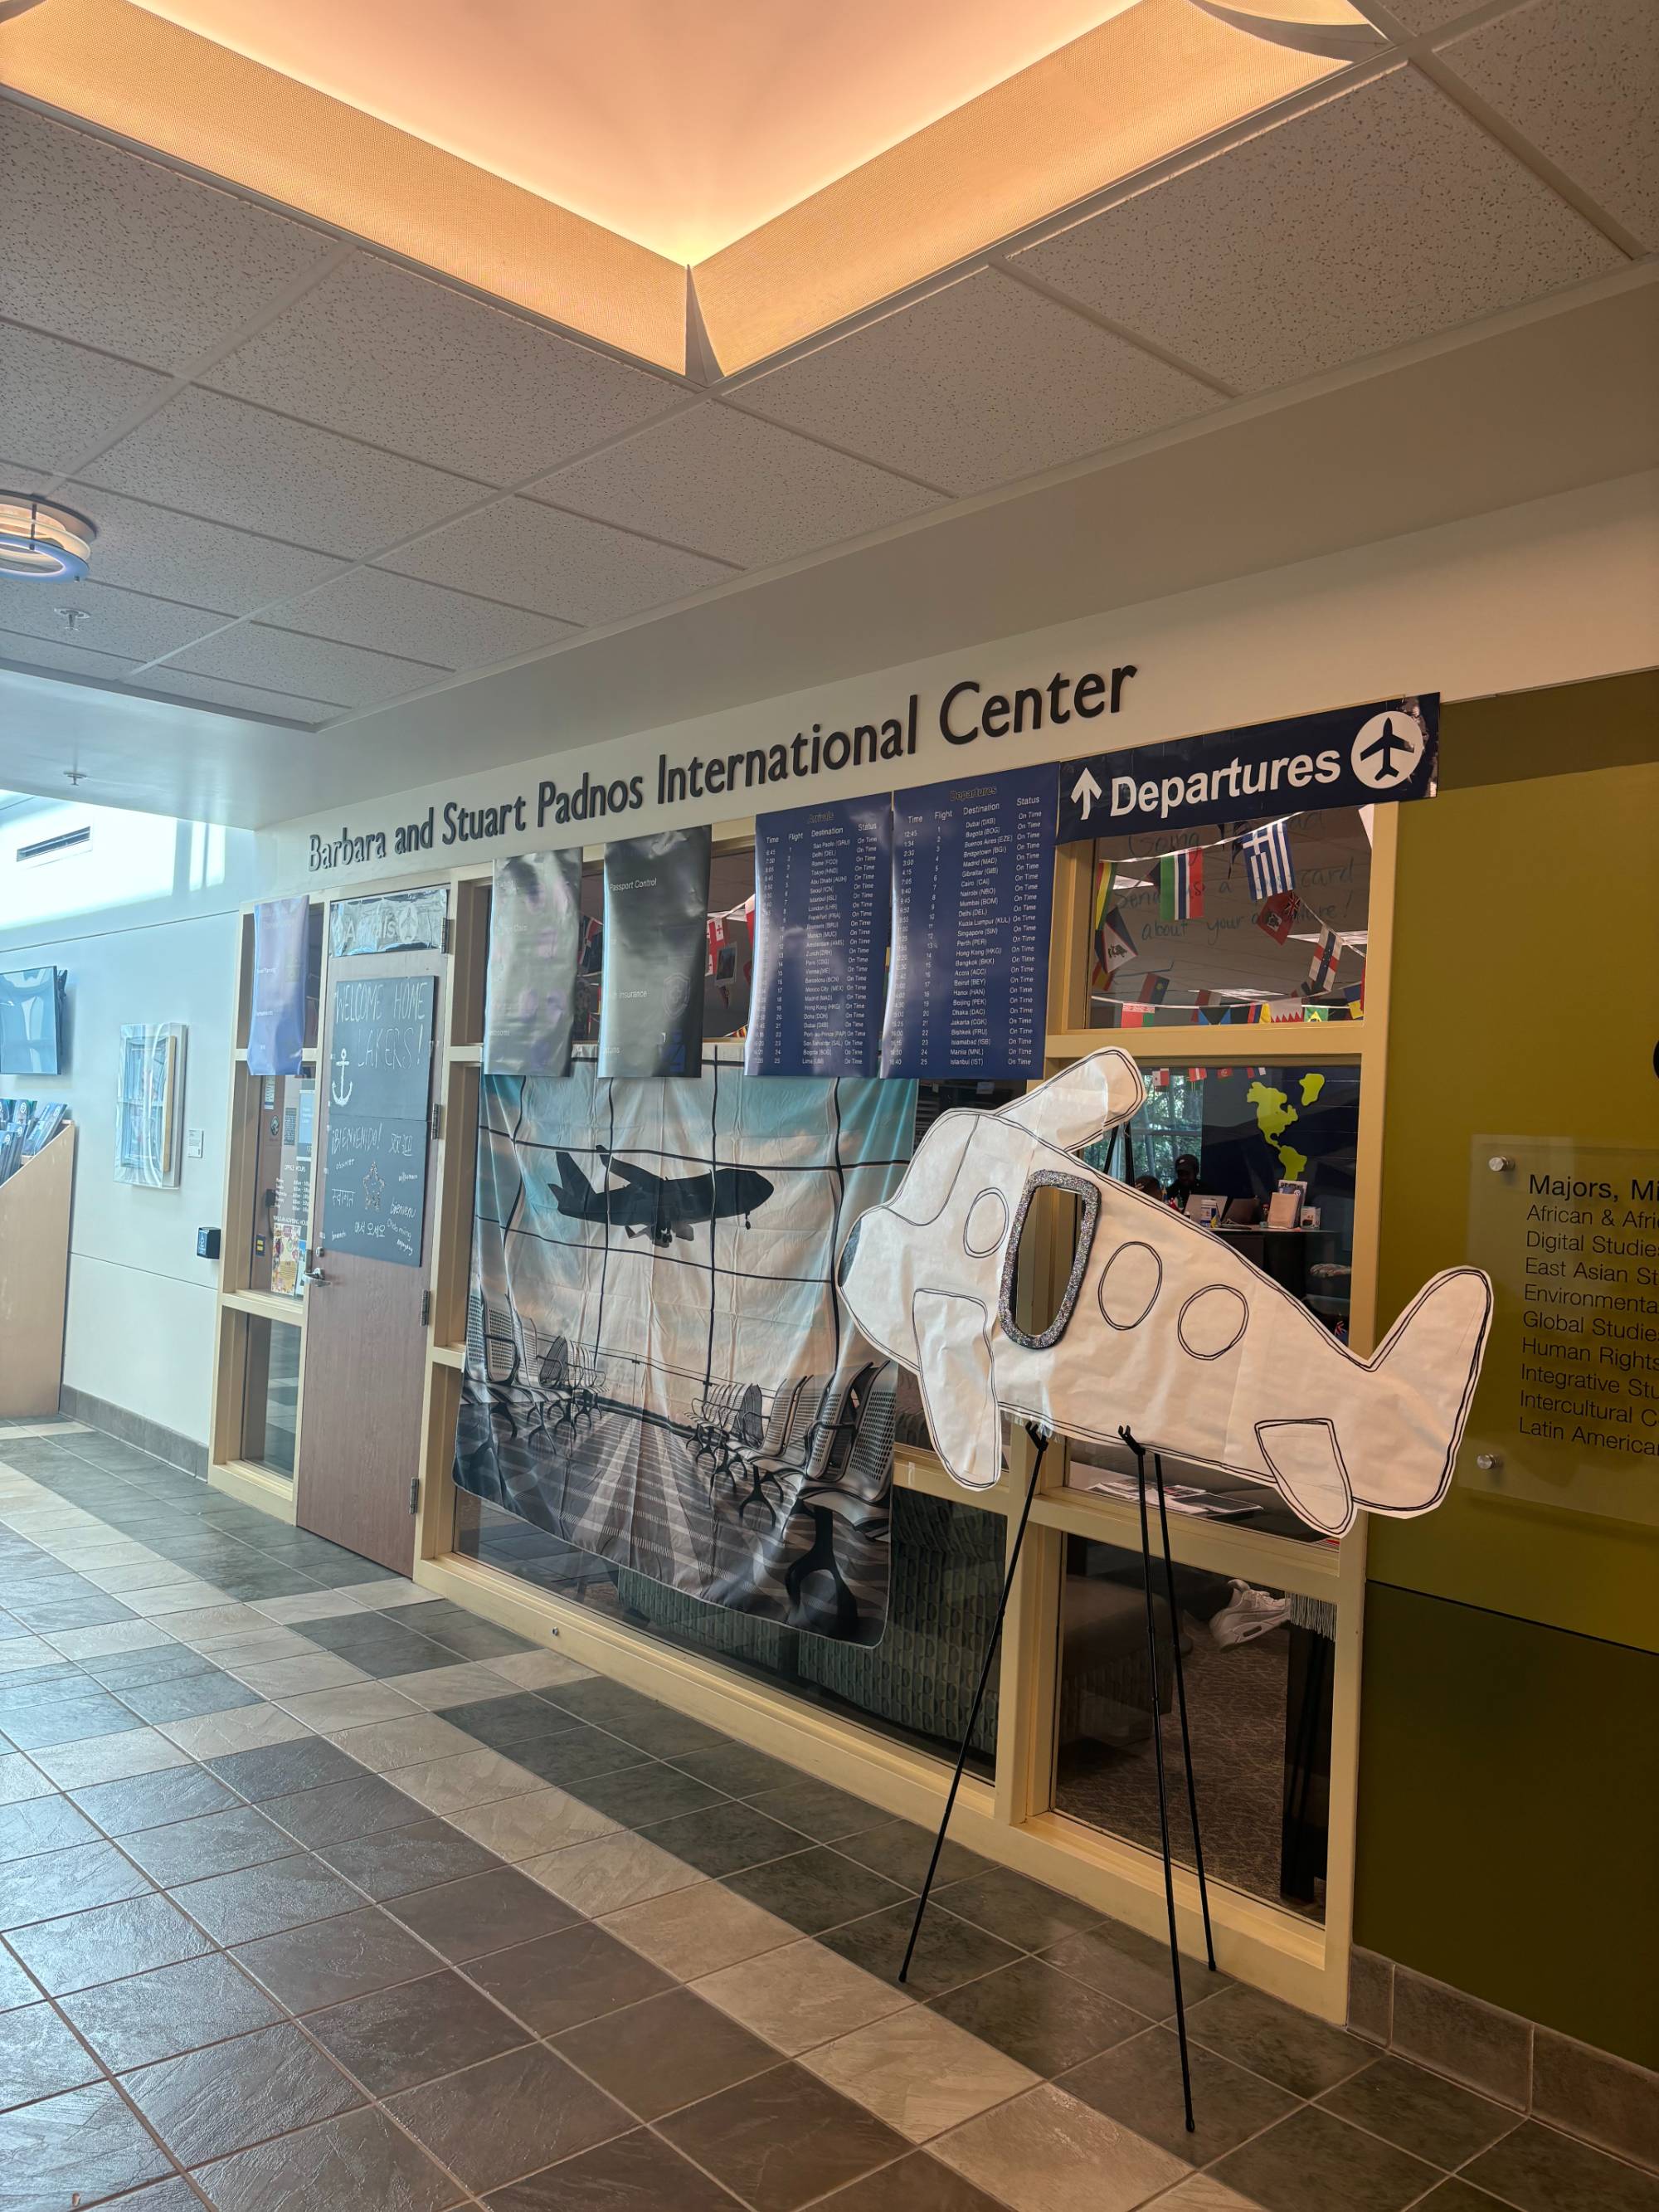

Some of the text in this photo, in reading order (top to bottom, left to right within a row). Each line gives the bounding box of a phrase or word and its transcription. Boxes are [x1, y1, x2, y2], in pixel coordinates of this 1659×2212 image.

[309, 664, 1138, 871] Barbara and Stuart Padnos International Center
[950, 786, 996, 801] Departures
[1110, 749, 1340, 819] Departures
[935, 811, 952, 821] Flight
[963, 802, 1000, 816] Destination
[1016, 797, 1040, 806] Status
[789, 832, 803, 841] Flight
[811, 827, 843, 837] Destination
[859, 823, 876, 831] Status
[610, 878, 657, 892] Passport Control
[973, 908, 987, 916] (DEL)
[981, 898, 998, 906] (BOM)
[957, 928, 983, 937] Singapore
[972, 938, 987, 947] (PER)
[1141, 923, 1189, 941] about
[1206, 915, 1244, 946] your
[970, 988, 985, 996] (HAN)
[971, 978, 985, 987] (BEY)
[334, 982, 428, 1023] WELCOME HOME
[358, 1024, 423, 1069] LAKERS!
[1530, 1174, 1618, 1201] Majors,
[1527, 1205, 1659, 1230] African & Afri
[1526, 1230, 1659, 1258] Digital Studie
[1526, 1257, 1566, 1277] East
[1574, 1262, 1627, 1283] Asian
[1523, 1311, 1659, 1342] Global Studie
[1522, 1337, 1659, 1371] Human Rights
[1521, 1363, 1619, 1393] Integrative
[1520, 1390, 1632, 1424] Intercultural
[1520, 1417, 1659, 1455] Latin America
